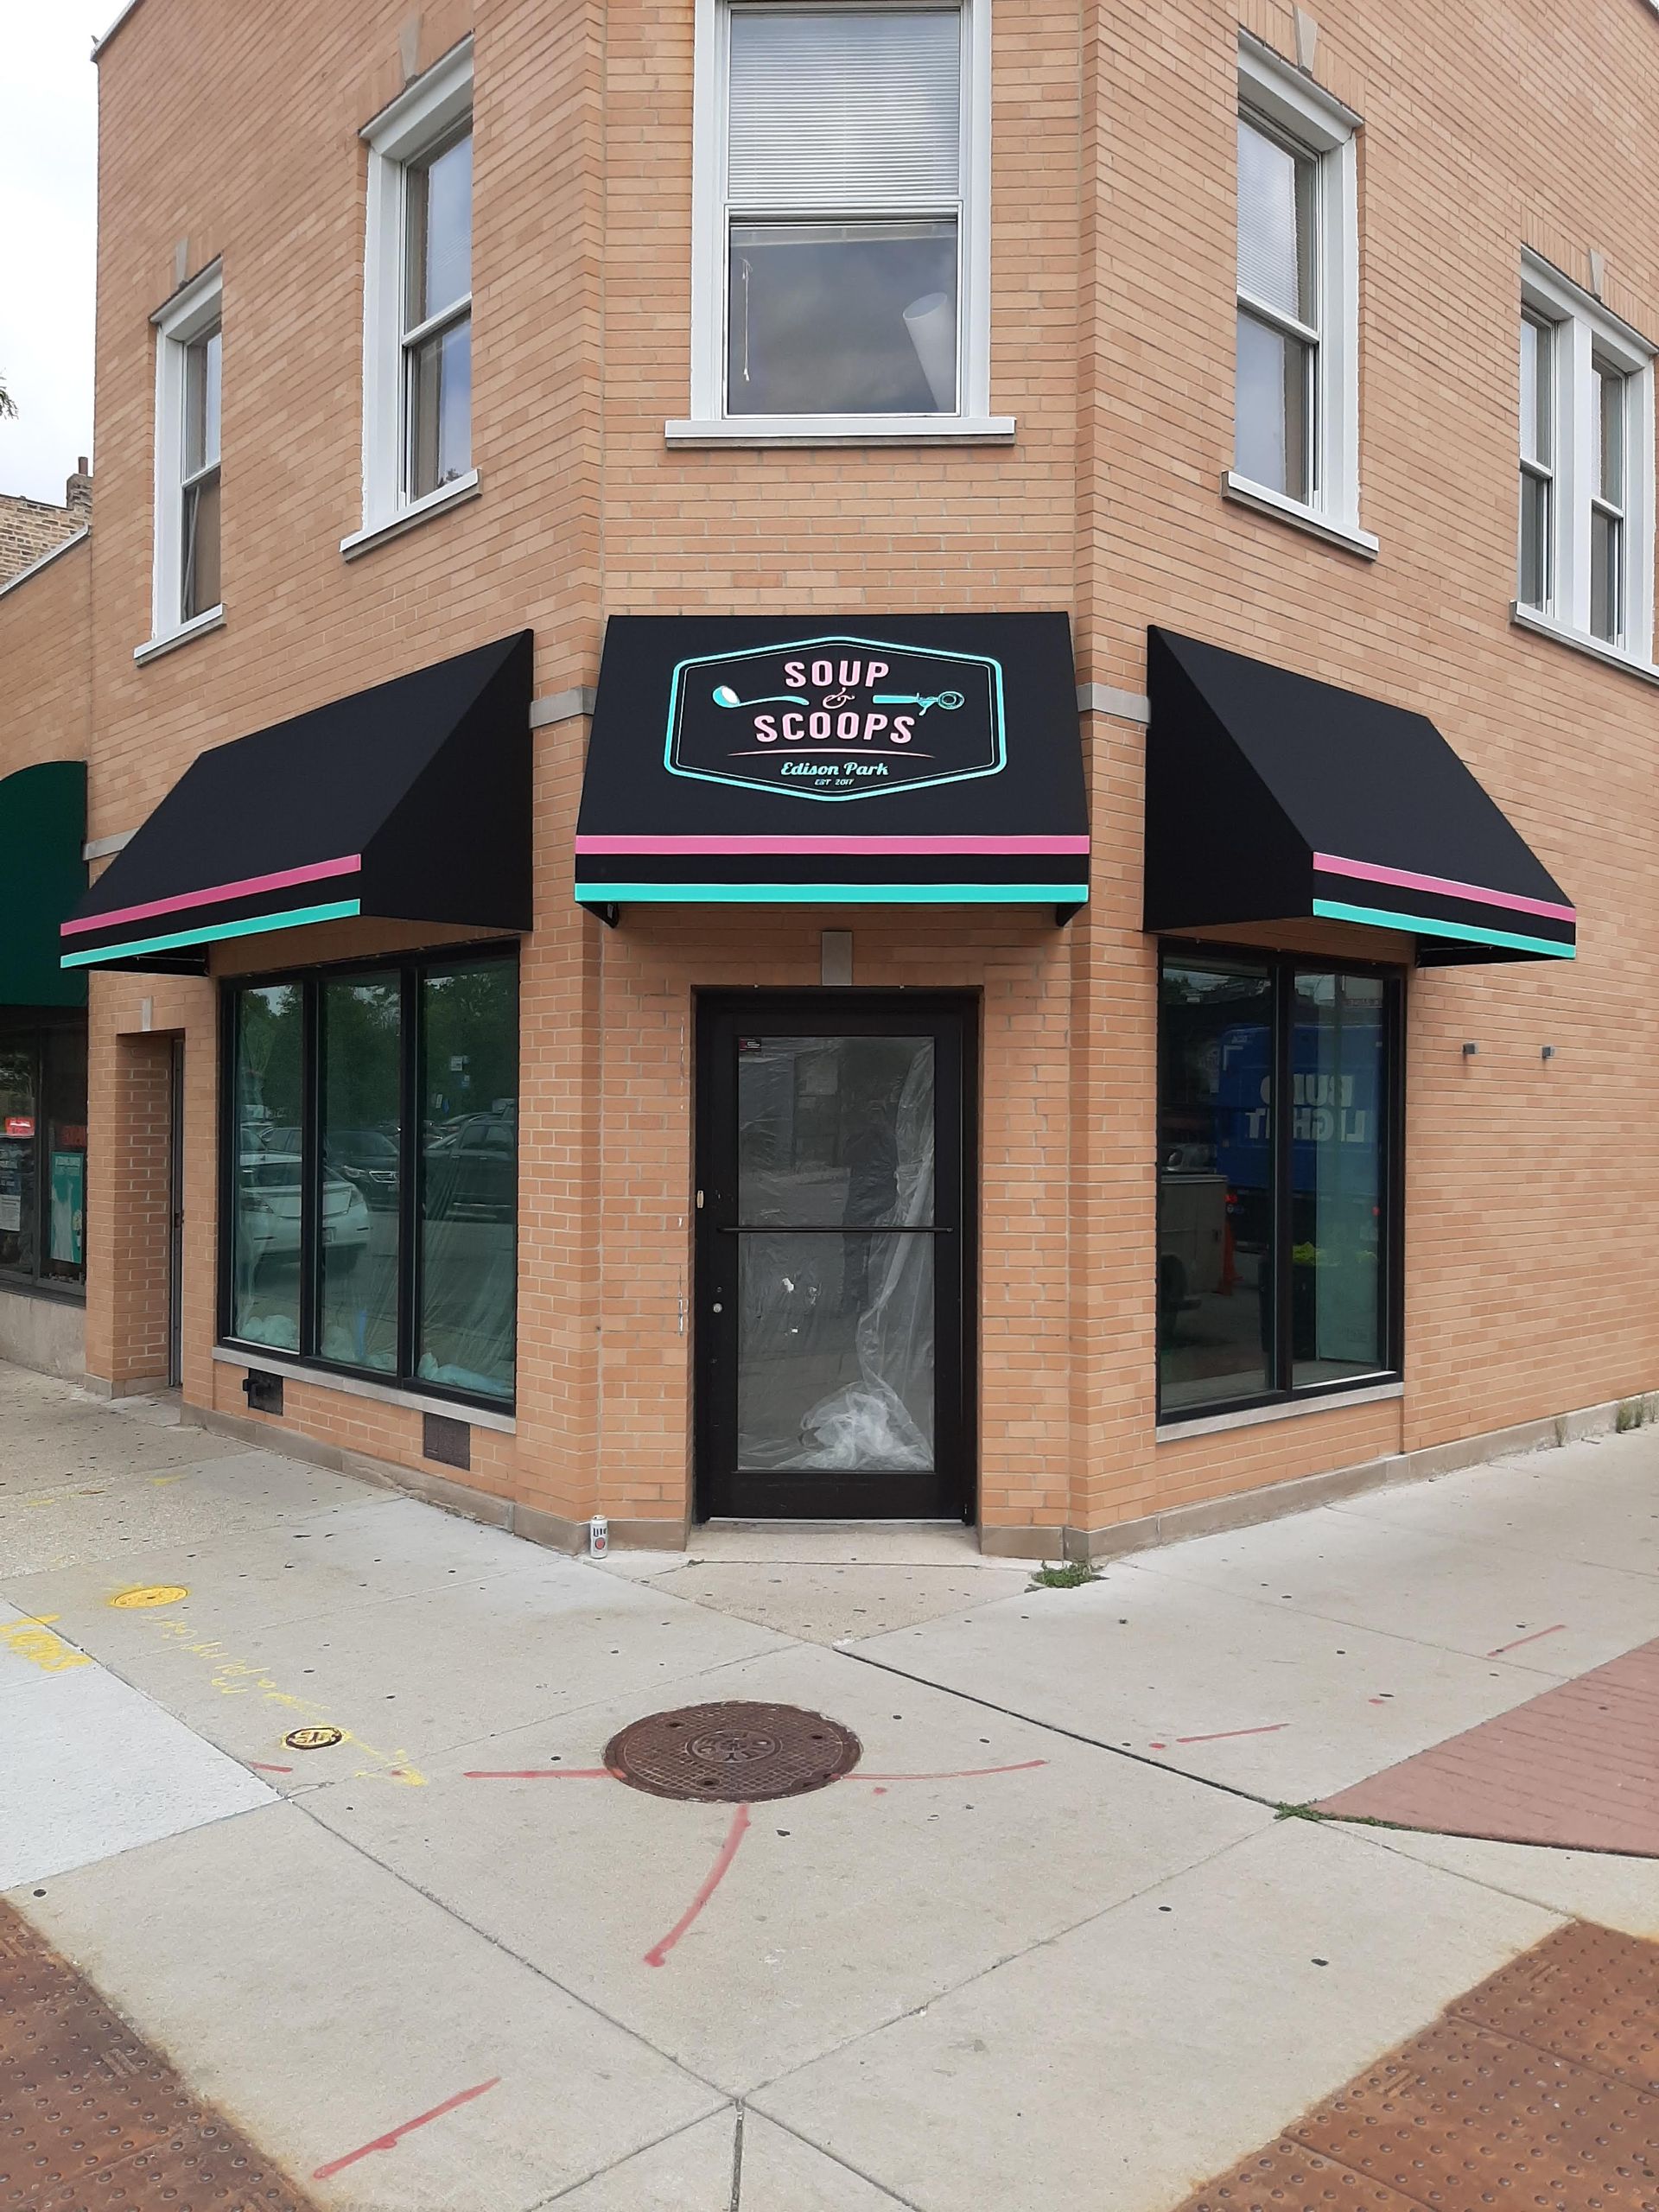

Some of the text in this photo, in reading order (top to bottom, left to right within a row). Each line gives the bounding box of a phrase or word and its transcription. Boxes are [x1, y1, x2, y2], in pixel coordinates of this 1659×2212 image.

[784, 660, 889, 688] SOUP
[822, 687, 855, 709] &
[753, 711, 916, 744] SCOOPS
[780, 761, 889, 776] Edison Park
